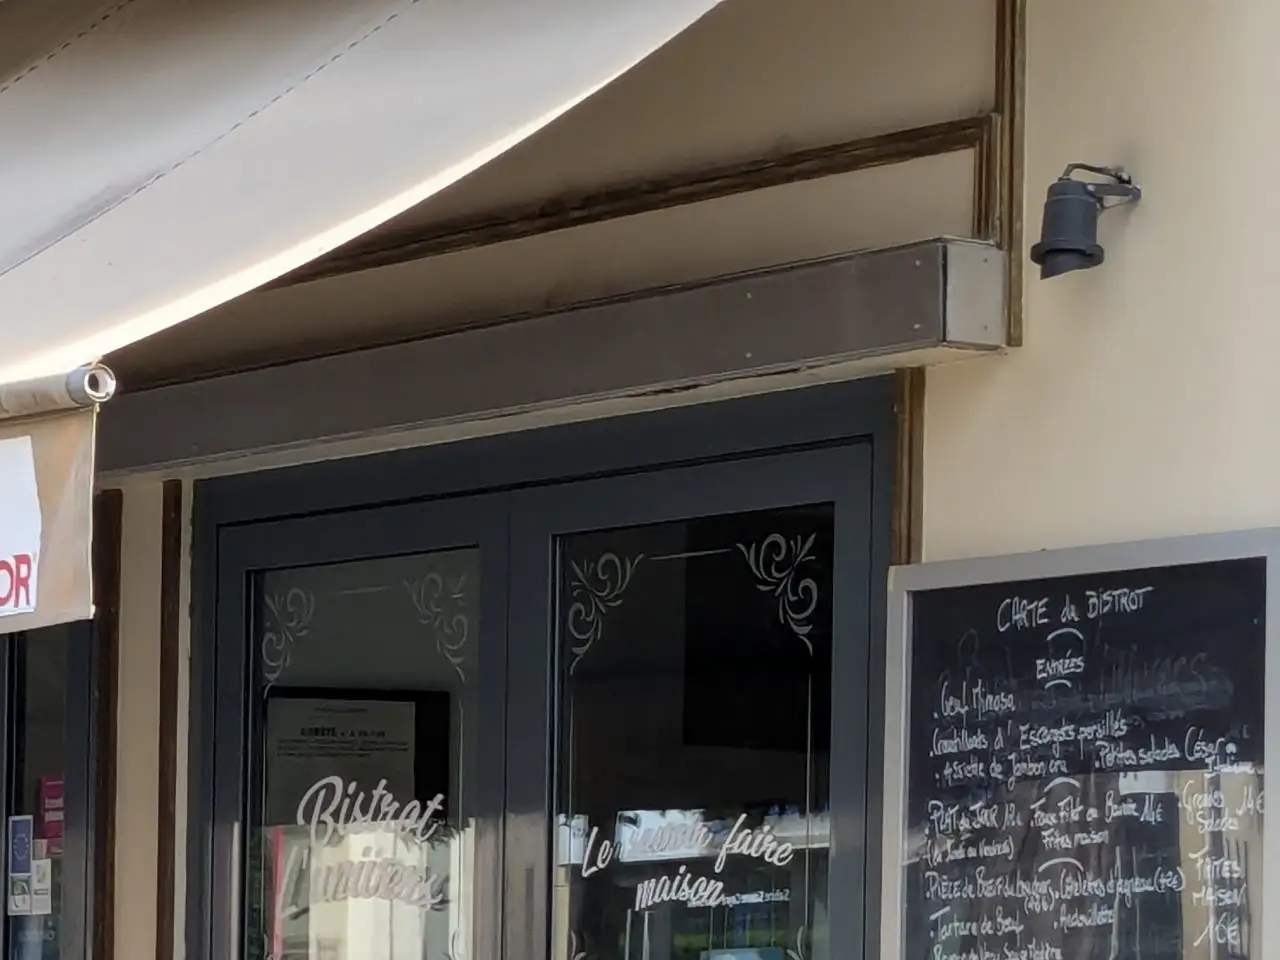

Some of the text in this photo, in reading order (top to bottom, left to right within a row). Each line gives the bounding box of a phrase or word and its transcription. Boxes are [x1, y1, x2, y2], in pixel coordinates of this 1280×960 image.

[997, 597, 1049, 632] CARTE
[297, 775, 446, 848] Bistrot
[581, 826, 614, 878] Le
[714, 812, 795, 874] faire
[635, 864, 725, 912] maison
